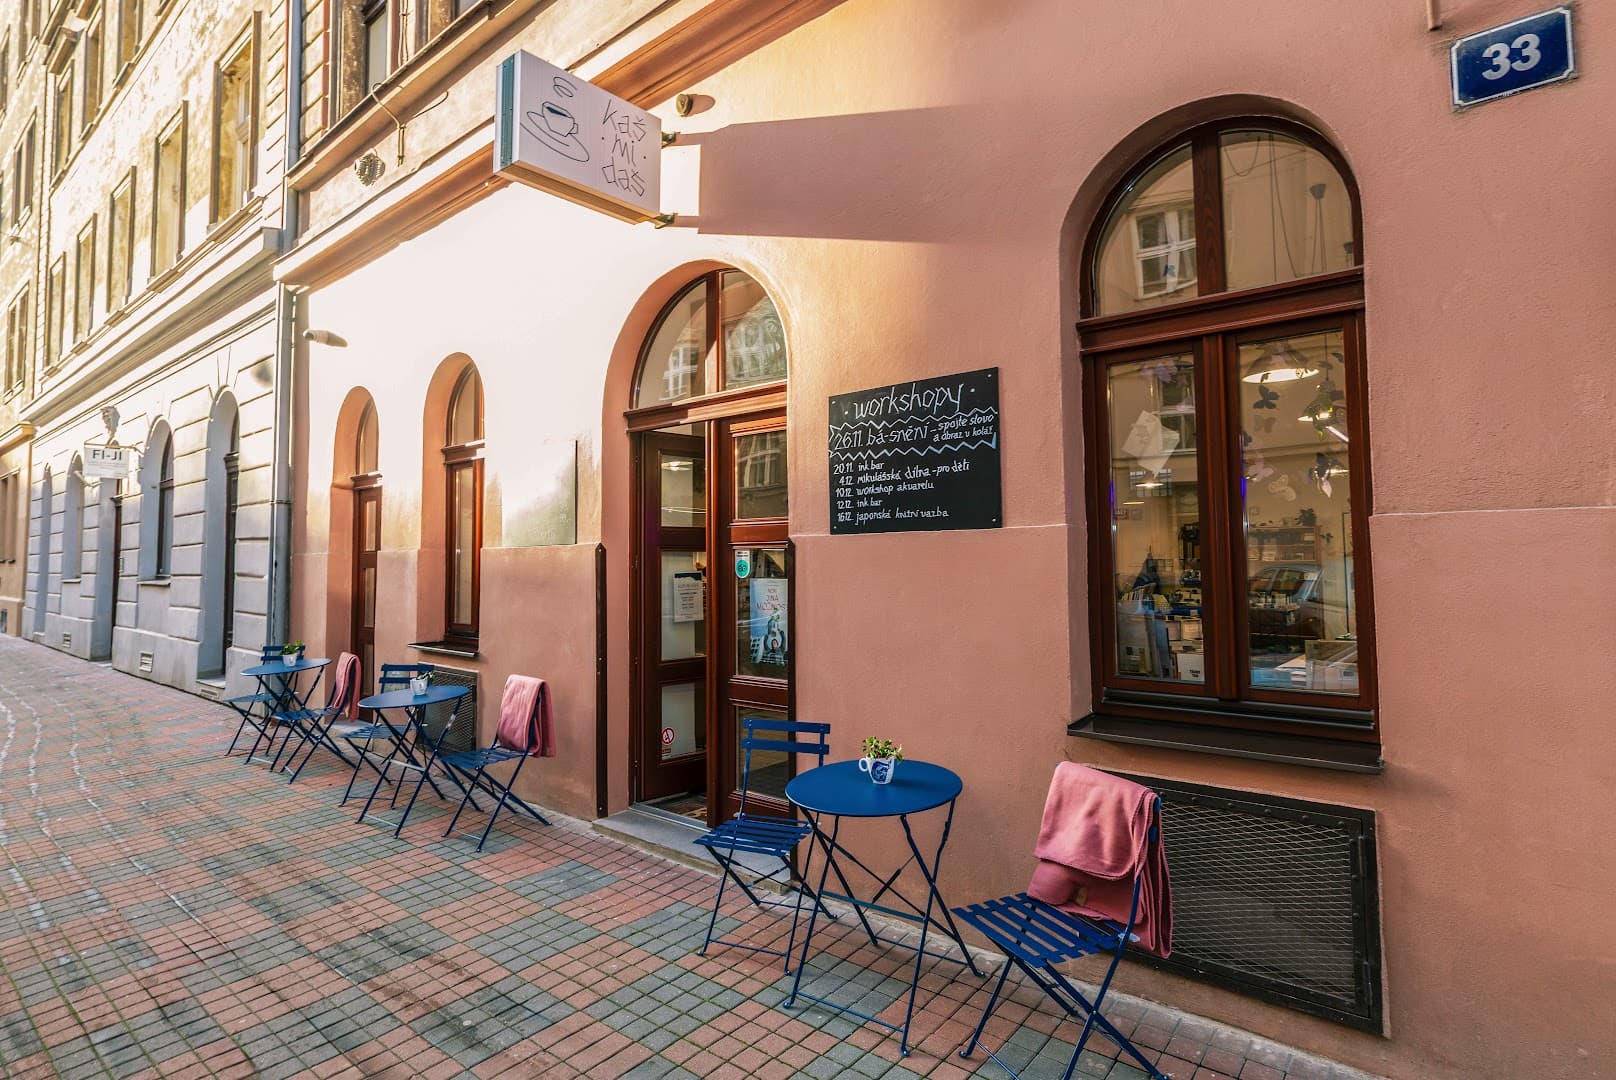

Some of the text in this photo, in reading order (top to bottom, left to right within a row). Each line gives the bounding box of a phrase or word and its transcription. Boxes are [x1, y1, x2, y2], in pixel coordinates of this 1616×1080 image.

[1482, 33, 1541, 80] 33
[853, 383, 964, 419] workshopy
[969, 414, 994, 426] slovo
[933, 434, 940, 442] a
[941, 431, 963, 441] obraz
[92, 449, 122, 460] FI-JI
[858, 460, 870, 472] ink
[871, 460, 885, 470] bar
[904, 465, 931, 479] dílna
[951, 459, 970, 473] děti
[856, 484, 893, 495] workshop
[857, 497, 868, 508] ink
[870, 497, 883, 507] bar
[854, 508, 891, 525] japonská
[920, 506, 949, 518] vazba
